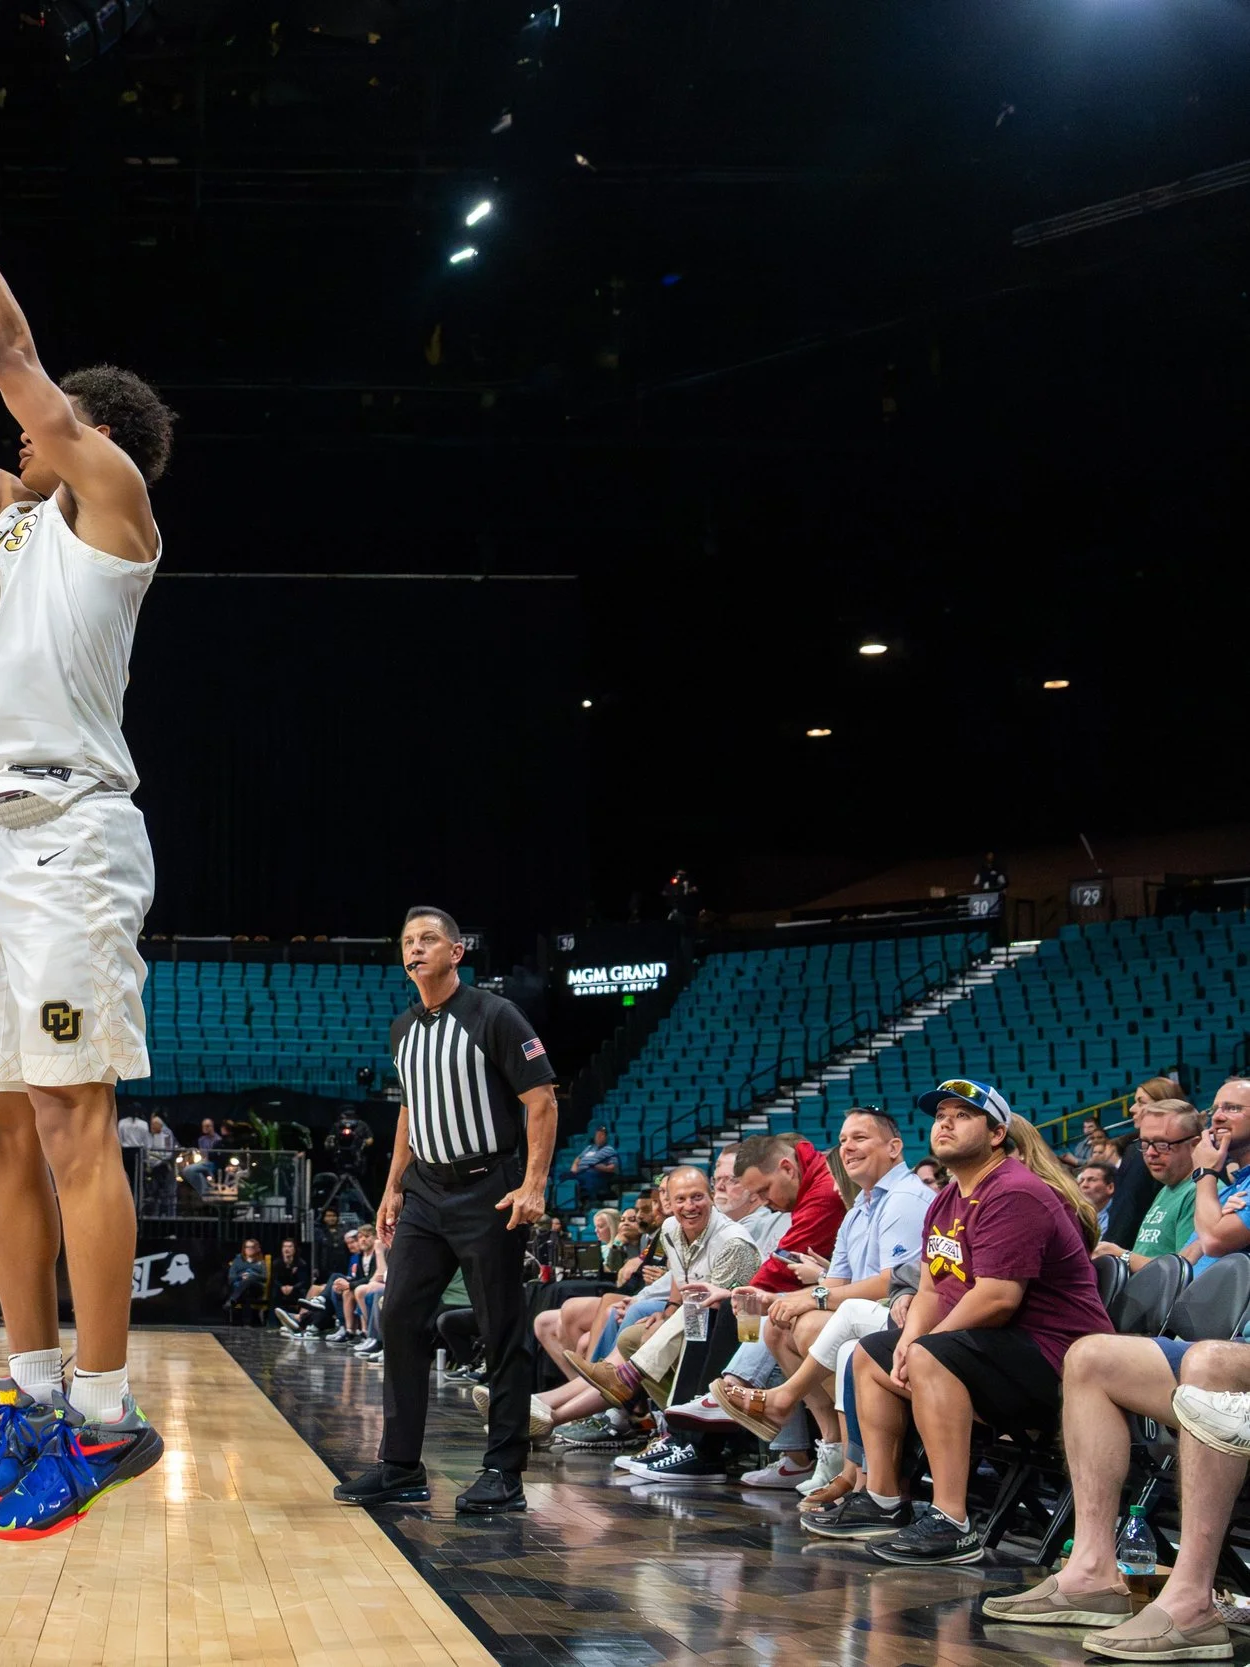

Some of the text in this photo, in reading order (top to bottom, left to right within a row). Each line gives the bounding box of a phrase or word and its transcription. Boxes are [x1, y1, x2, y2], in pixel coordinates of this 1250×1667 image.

[1083, 890, 1100, 906] 29
[972, 901, 989, 916] 30
[567, 962, 667, 985] MGM GRAND
[573, 984, 618, 996] GARDEN
[956, 1531, 979, 1550] HOKA
